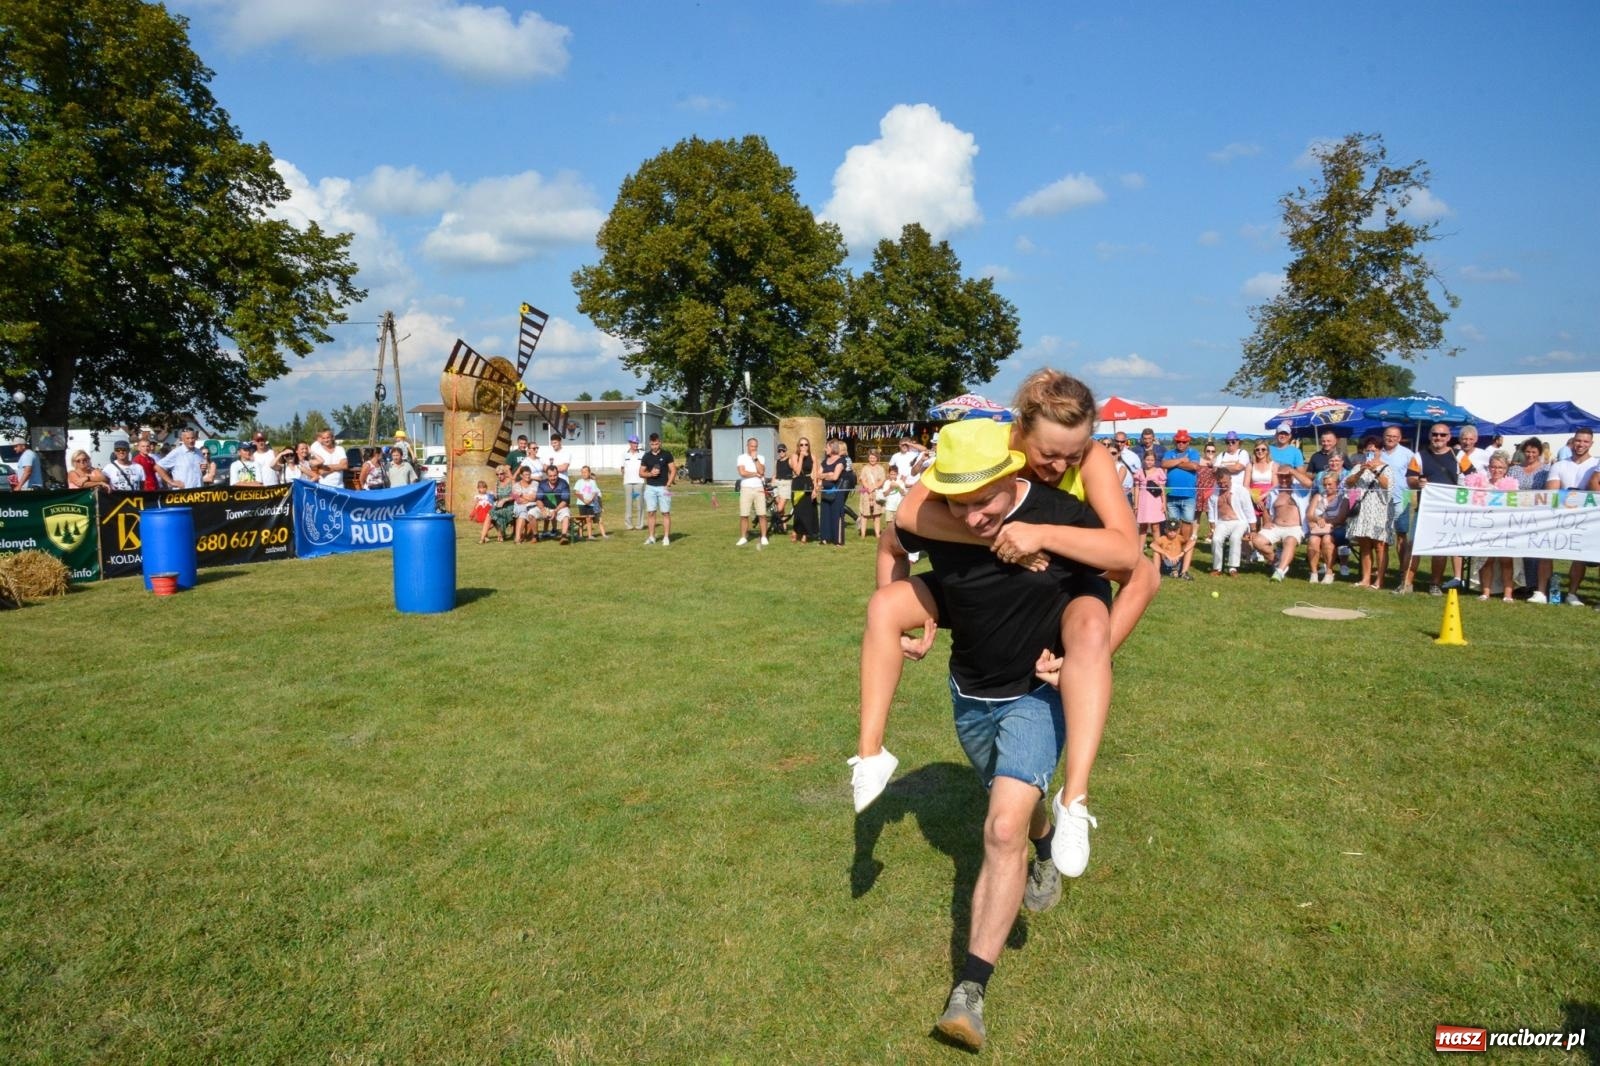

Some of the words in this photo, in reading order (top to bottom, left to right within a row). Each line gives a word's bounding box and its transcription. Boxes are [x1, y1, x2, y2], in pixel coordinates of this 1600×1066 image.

[350, 504, 406, 522] GMINA
[1508, 513, 1537, 529] NA
[196, 533, 228, 552] 680
[230, 530, 258, 549] 667
[260, 527, 288, 545] 860
[350, 522, 394, 545] RUD
[110, 554, 143, 566] KOLDA
